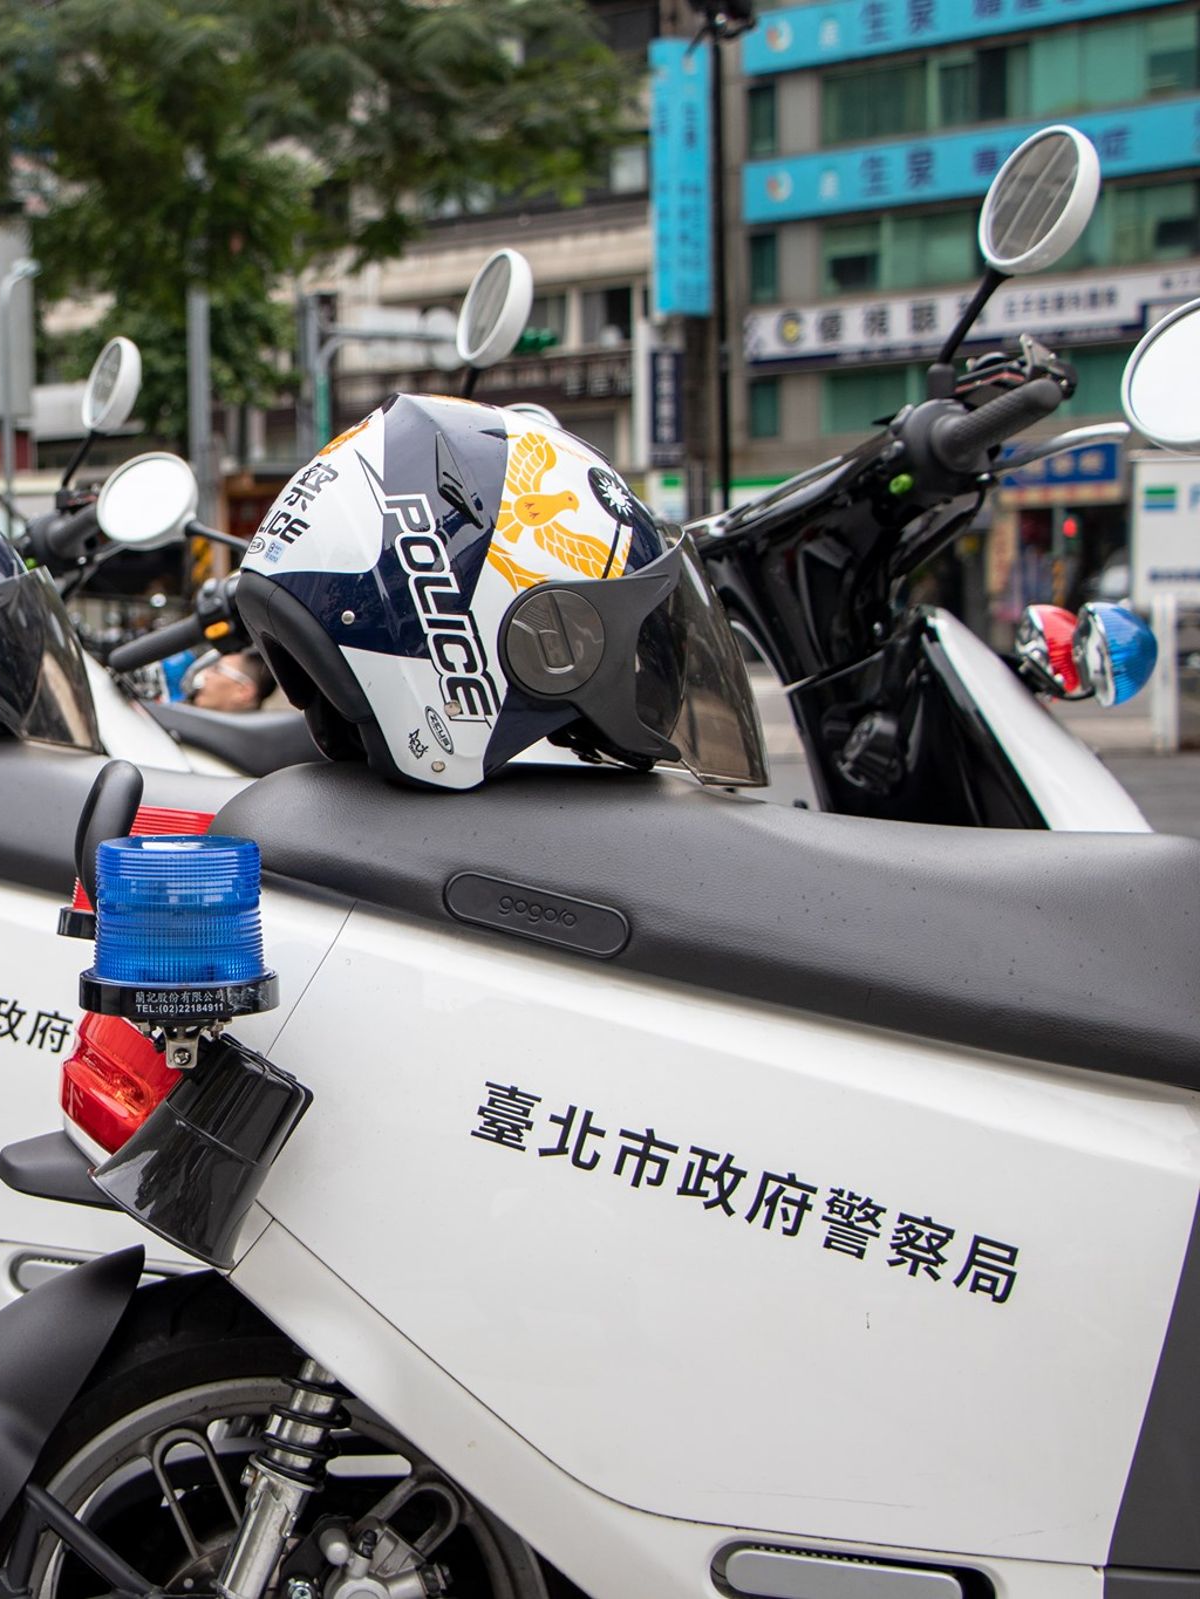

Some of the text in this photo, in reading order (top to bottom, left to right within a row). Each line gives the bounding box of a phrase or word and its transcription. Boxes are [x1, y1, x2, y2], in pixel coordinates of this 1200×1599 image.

[384, 493, 499, 723] POLICE
[497, 895, 579, 928] gogoro
[135, 1001, 225, 1014] TEL:(02)22184911
[469, 1080, 1023, 1305] 臺北市政府警察局
